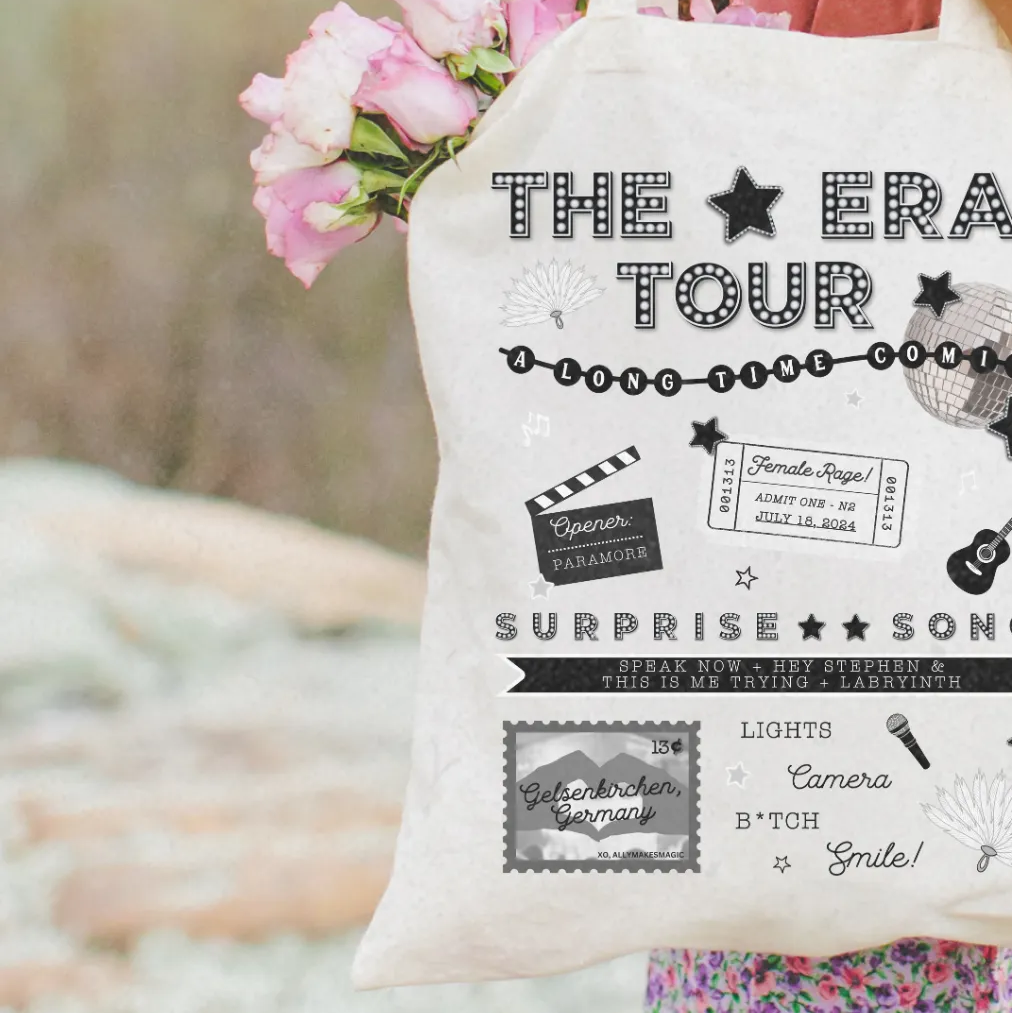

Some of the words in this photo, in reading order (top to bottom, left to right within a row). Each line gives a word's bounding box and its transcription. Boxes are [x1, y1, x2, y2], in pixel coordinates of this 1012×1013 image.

[491, 171, 672, 238] THE
[616, 261, 873, 329] TOUR
[560, 362, 675, 390] LONG
[715, 354, 826, 389] TIME
[747, 455, 815, 476] Female
[816, 462, 873, 485] Rage!
[719, 458, 736, 513] 001313
[755, 493, 797, 506] ADMIT
[799, 497, 826, 509] ONE
[881, 476, 897, 531] 001313
[550, 515, 633, 540] Opener:
[755, 511, 793, 524] JULY
[799, 515, 818, 529] 18,
[822, 518, 856, 531] 2024
[553, 546, 648, 571] PARAMORE
[495, 612, 779, 641] SURPRISE
[619, 660, 687, 673] SPEAK
[698, 660, 742, 673] NOW
[774, 660, 814, 673] HEY
[824, 660, 921, 673] STEPHEN
[931, 660, 945, 673] &
[602, 675, 650, 688] THIS
[661, 675, 680, 688] IS
[690, 675, 719, 688] ME
[730, 675, 809, 688] TRYING
[840, 675, 962, 689] LABRYINTH
[740, 721, 832, 739] LIGHTS
[787, 763, 893, 790] Camera
[519, 775, 682, 811] Gelsenkirchen,
[551, 803, 657, 831] Germany
[597, 851, 611, 859] XO,
[612, 851, 685, 859] ALLYMAKESMAGIC
[826, 841, 924, 876] Smile!
